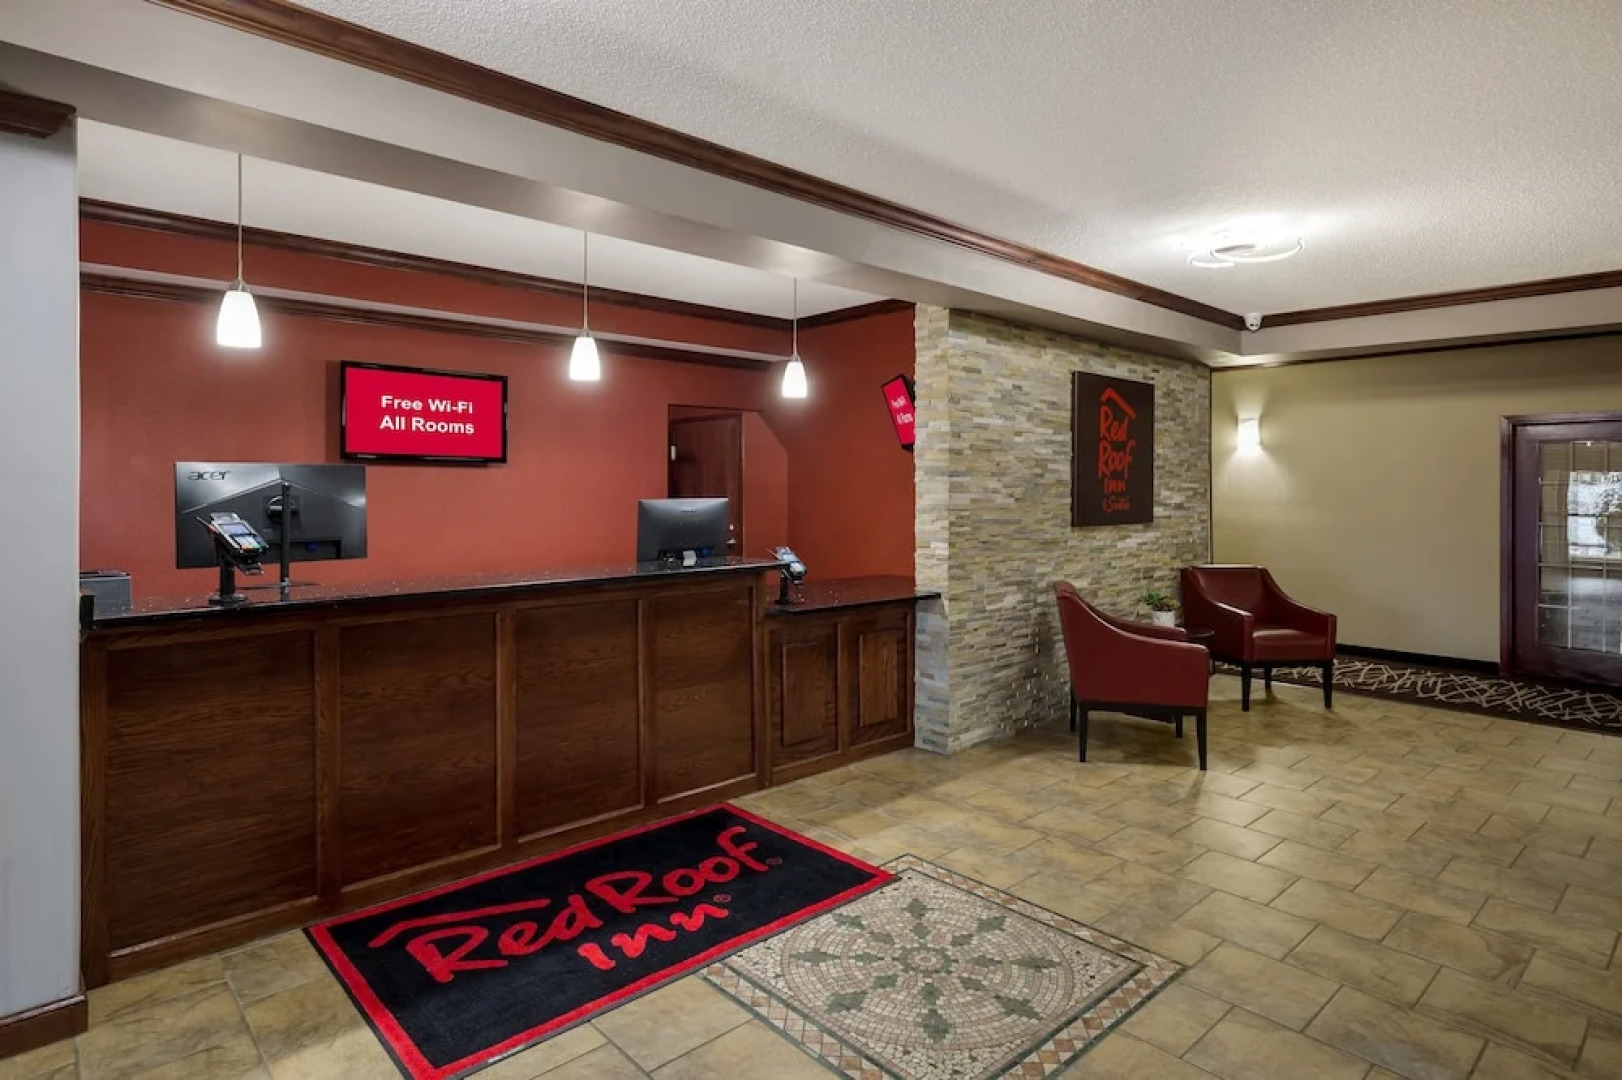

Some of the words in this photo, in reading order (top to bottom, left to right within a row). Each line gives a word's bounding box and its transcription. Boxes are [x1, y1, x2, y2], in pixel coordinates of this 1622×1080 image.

[380, 395, 423, 411] Free
[428, 398, 473, 414] Wi-Fi
[379, 415, 406, 430] All
[411, 416, 475, 434] Rooms
[1100, 405, 1129, 441] Red
[1098, 439, 1136, 480] Roof
[188, 470, 231, 481] acer
